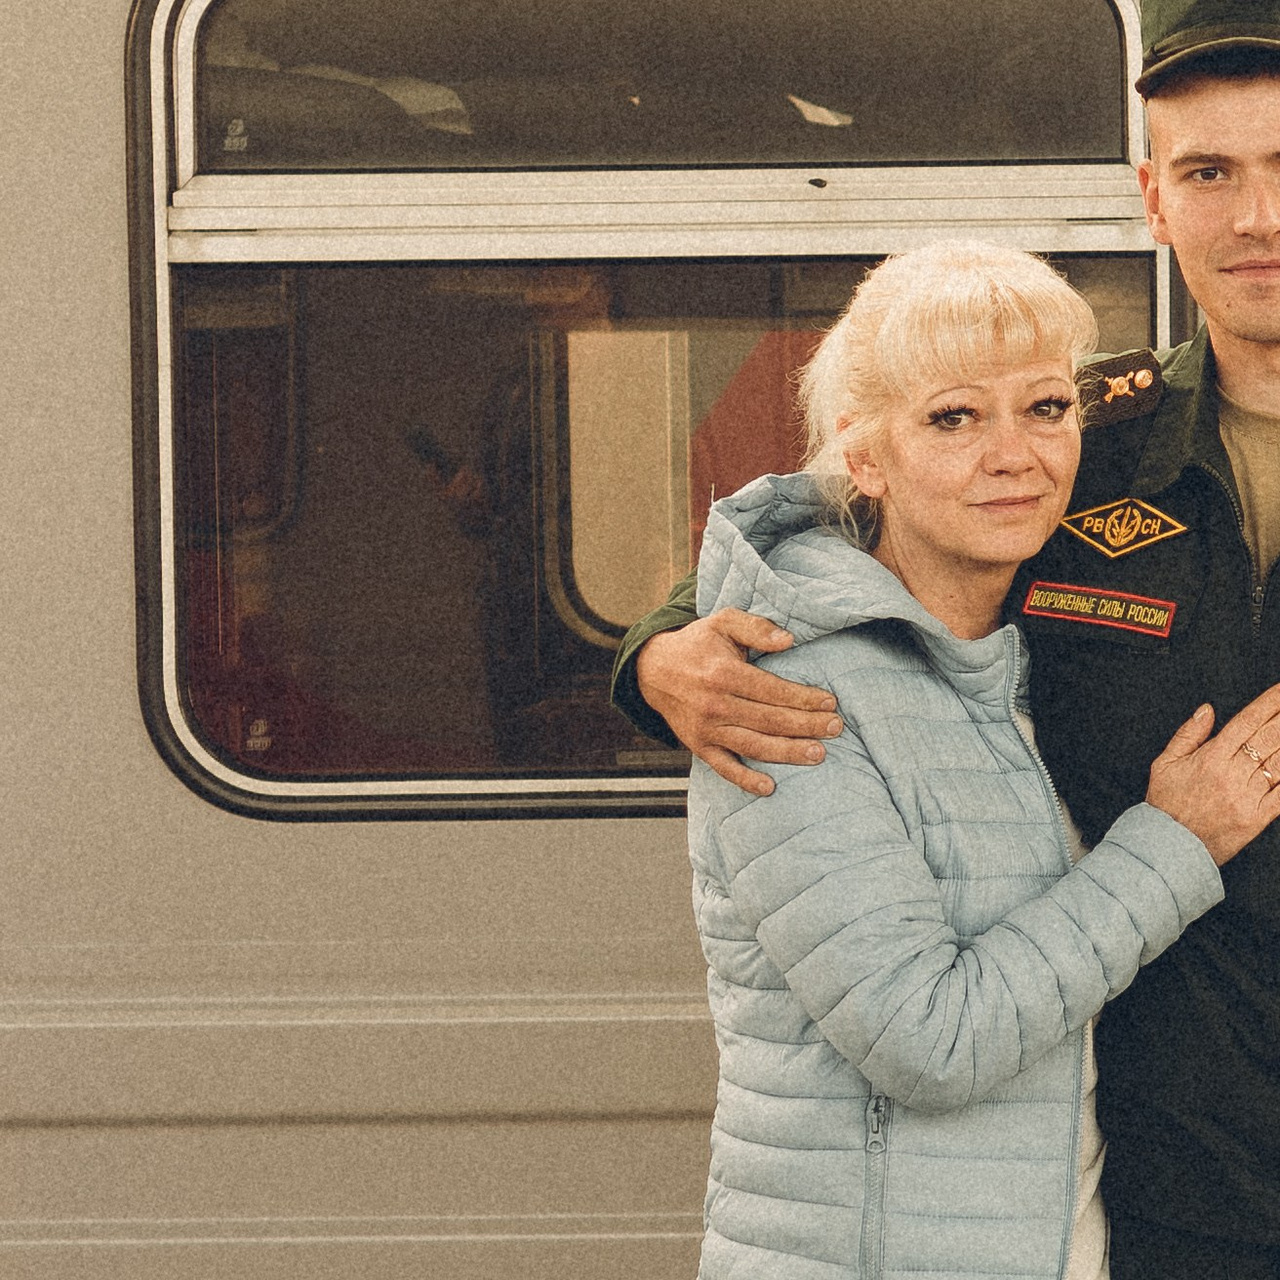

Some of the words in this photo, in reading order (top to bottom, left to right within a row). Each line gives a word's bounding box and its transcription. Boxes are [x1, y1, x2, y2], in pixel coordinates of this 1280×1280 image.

[1030, 589, 1097, 614] ВООРУЖЕННЫЕ
[1097, 599, 1125, 619] СИЛЫ
[1127, 604, 1169, 627] РОССИИ
